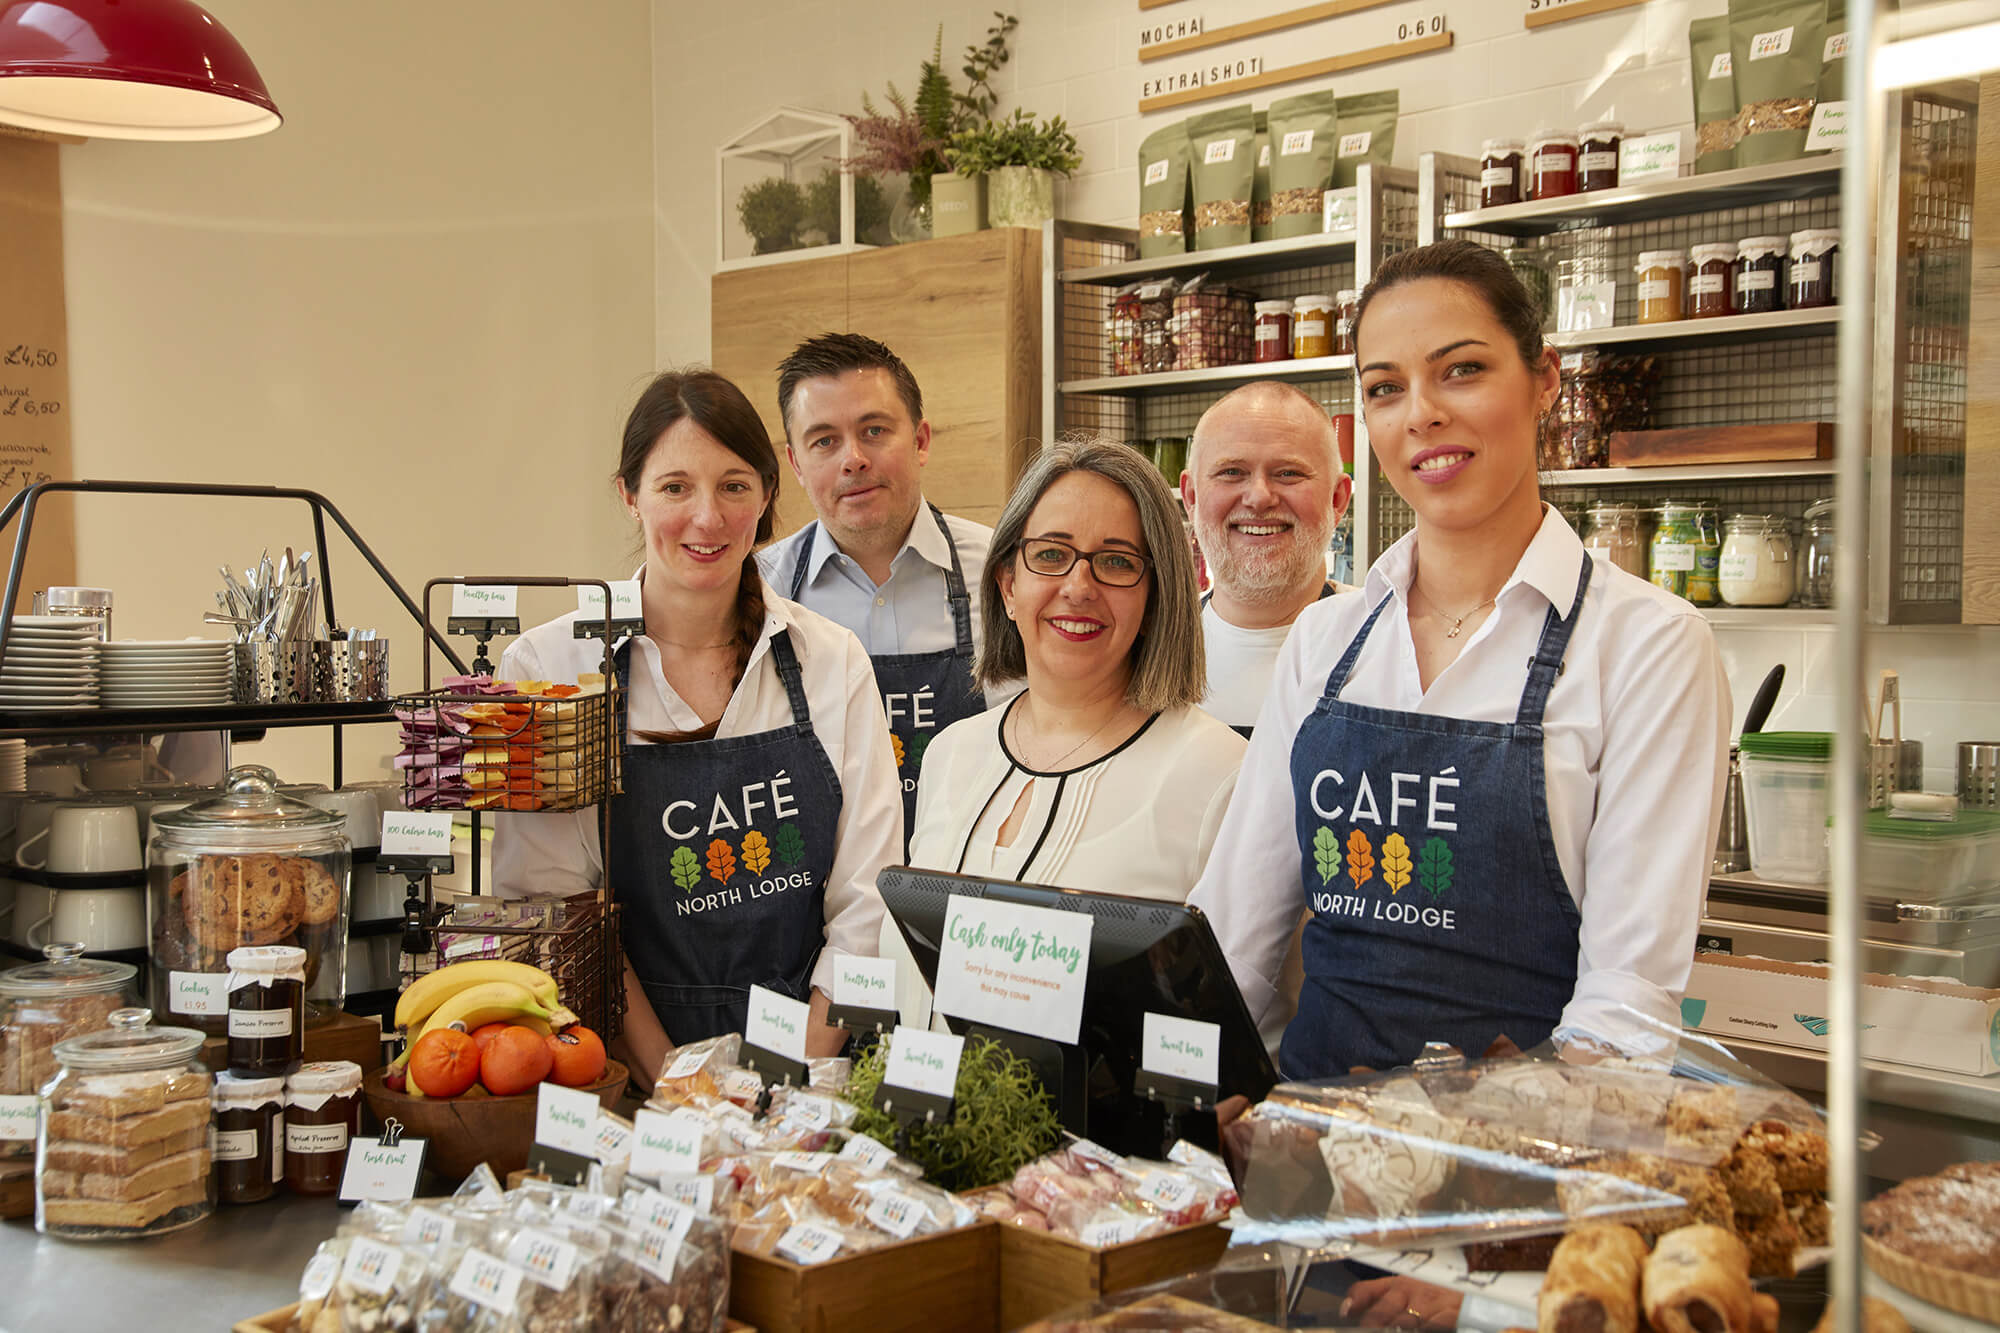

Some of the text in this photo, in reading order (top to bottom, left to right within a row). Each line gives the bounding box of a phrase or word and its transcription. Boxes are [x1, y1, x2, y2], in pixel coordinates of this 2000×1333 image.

[1141, 19, 1199, 45] MOCHA
[1398, 16, 1441, 41] 0.60
[1143, 58, 1258, 97] EXTRA SHOT
[886, 684, 935, 729] FÉ
[662, 769, 799, 840] CAFÉ
[1310, 766, 1460, 831] CAFÉ
[676, 872, 812, 915] NORTH LODGE
[1313, 892, 1455, 929] NORTH LODGE
[949, 914, 1082, 974] Cash only today
[180, 981, 209, 995] Cookies
[964, 960, 1061, 991] Sorry for any inconvenience
[363, 1151, 406, 1165] Fresh fruit
